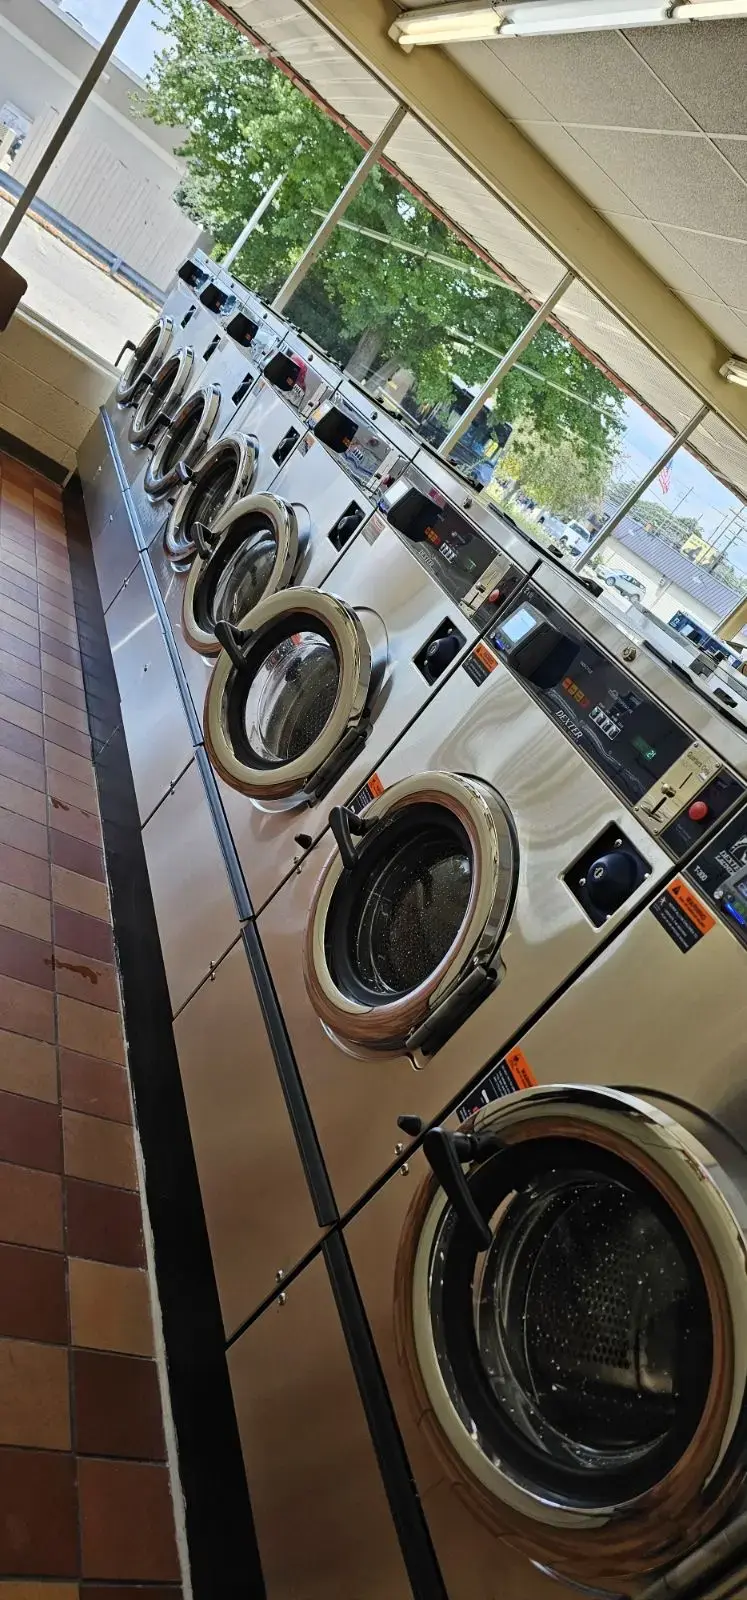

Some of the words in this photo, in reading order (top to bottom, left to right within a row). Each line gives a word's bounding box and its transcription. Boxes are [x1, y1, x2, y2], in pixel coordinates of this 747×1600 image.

[554, 708, 584, 739] DEXTER
[714, 855, 735, 876] LAUND
[719, 850, 741, 872] DEXTE
